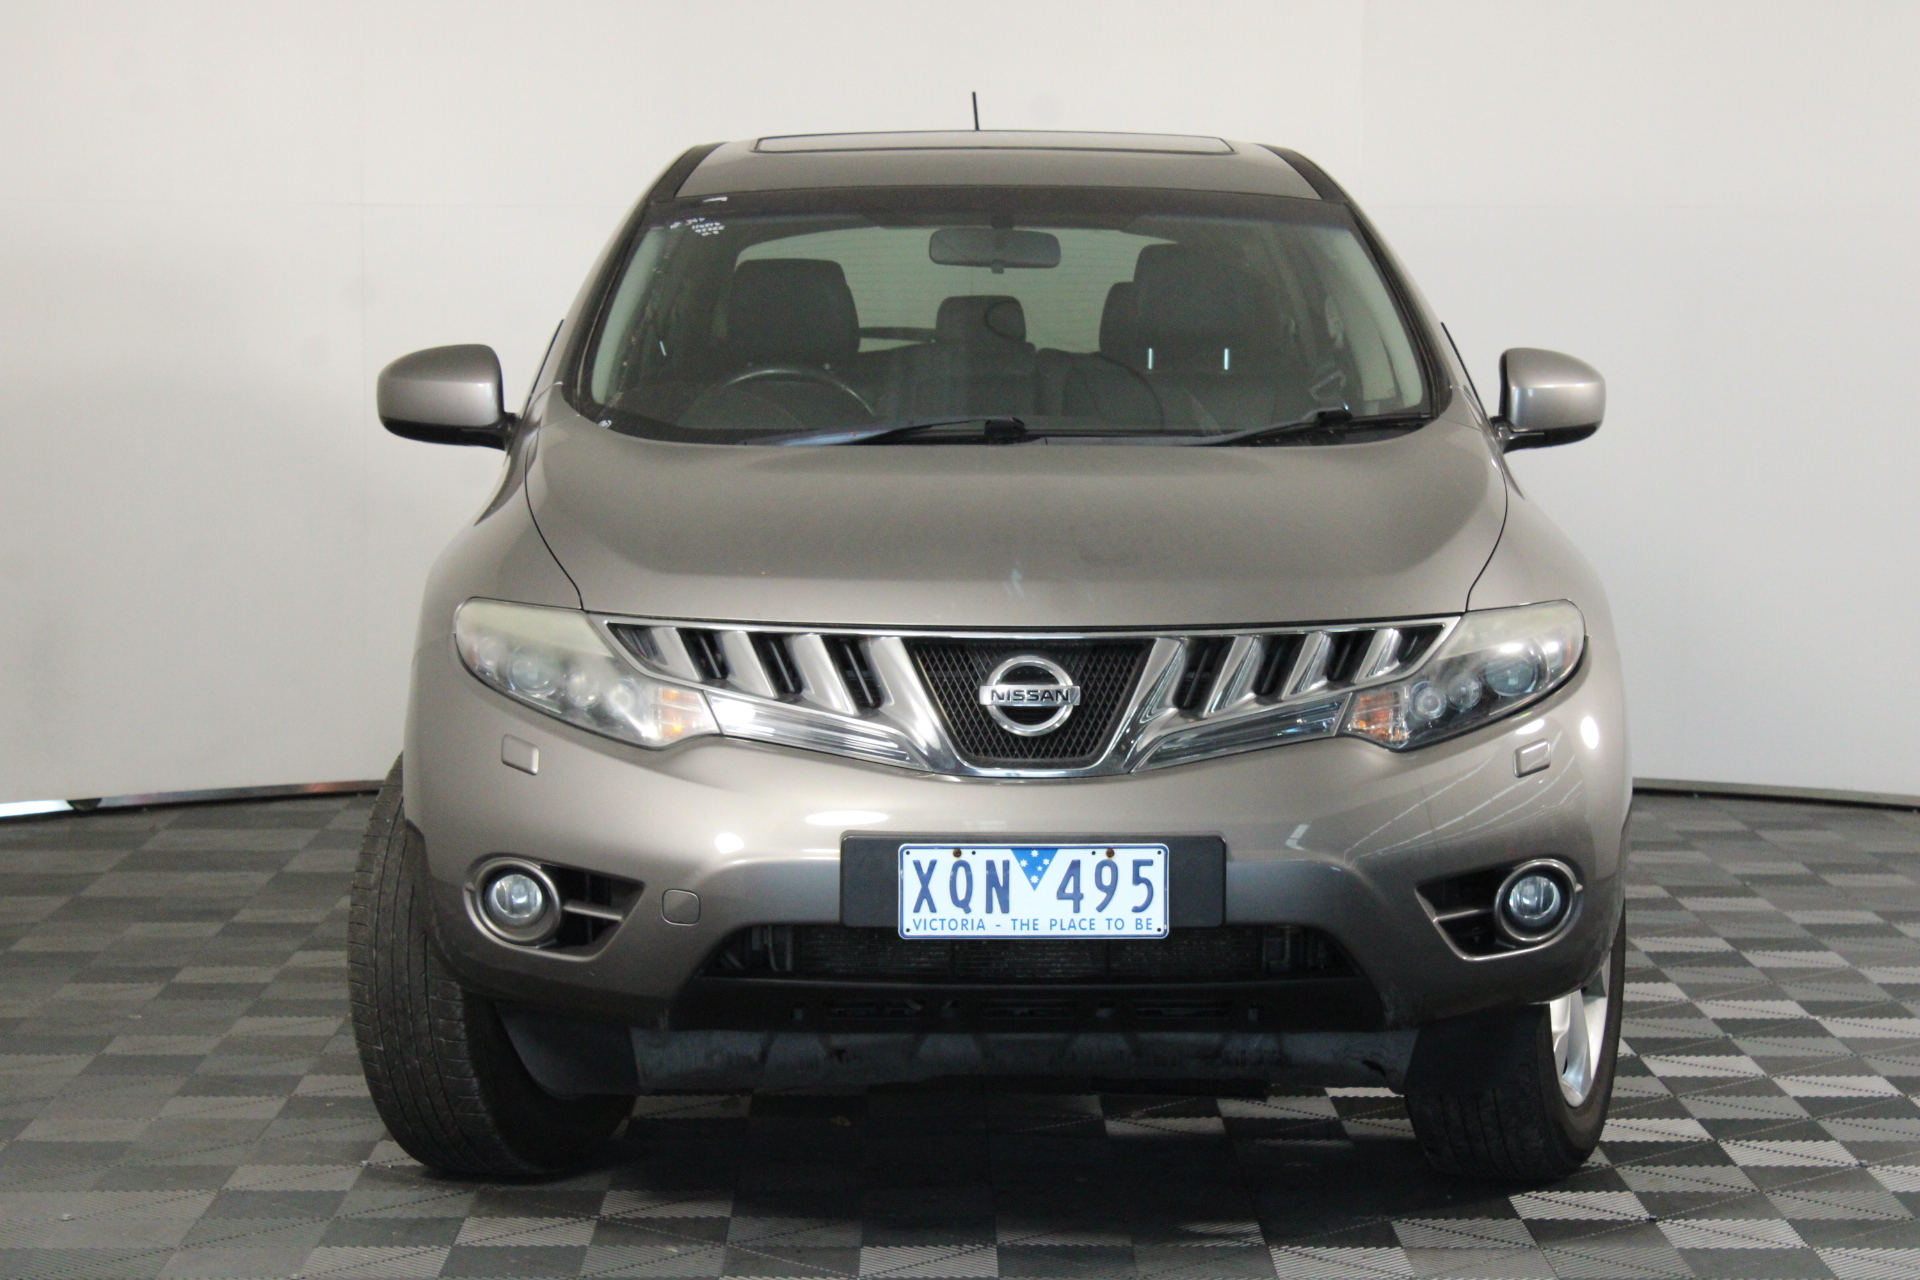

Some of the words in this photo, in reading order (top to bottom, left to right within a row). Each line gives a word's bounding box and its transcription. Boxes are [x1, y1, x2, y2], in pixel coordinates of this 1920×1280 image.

[990, 689, 1070, 703] NISSAN
[912, 858, 1011, 915] XQN
[1055, 858, 1155, 914] 495
[912, 917, 987, 931] VICTORIA
[1010, 917, 1040, 931] THE
[1049, 917, 1097, 931] PLACE
[1105, 917, 1126, 931] TO
[1135, 917, 1154, 931] BE
